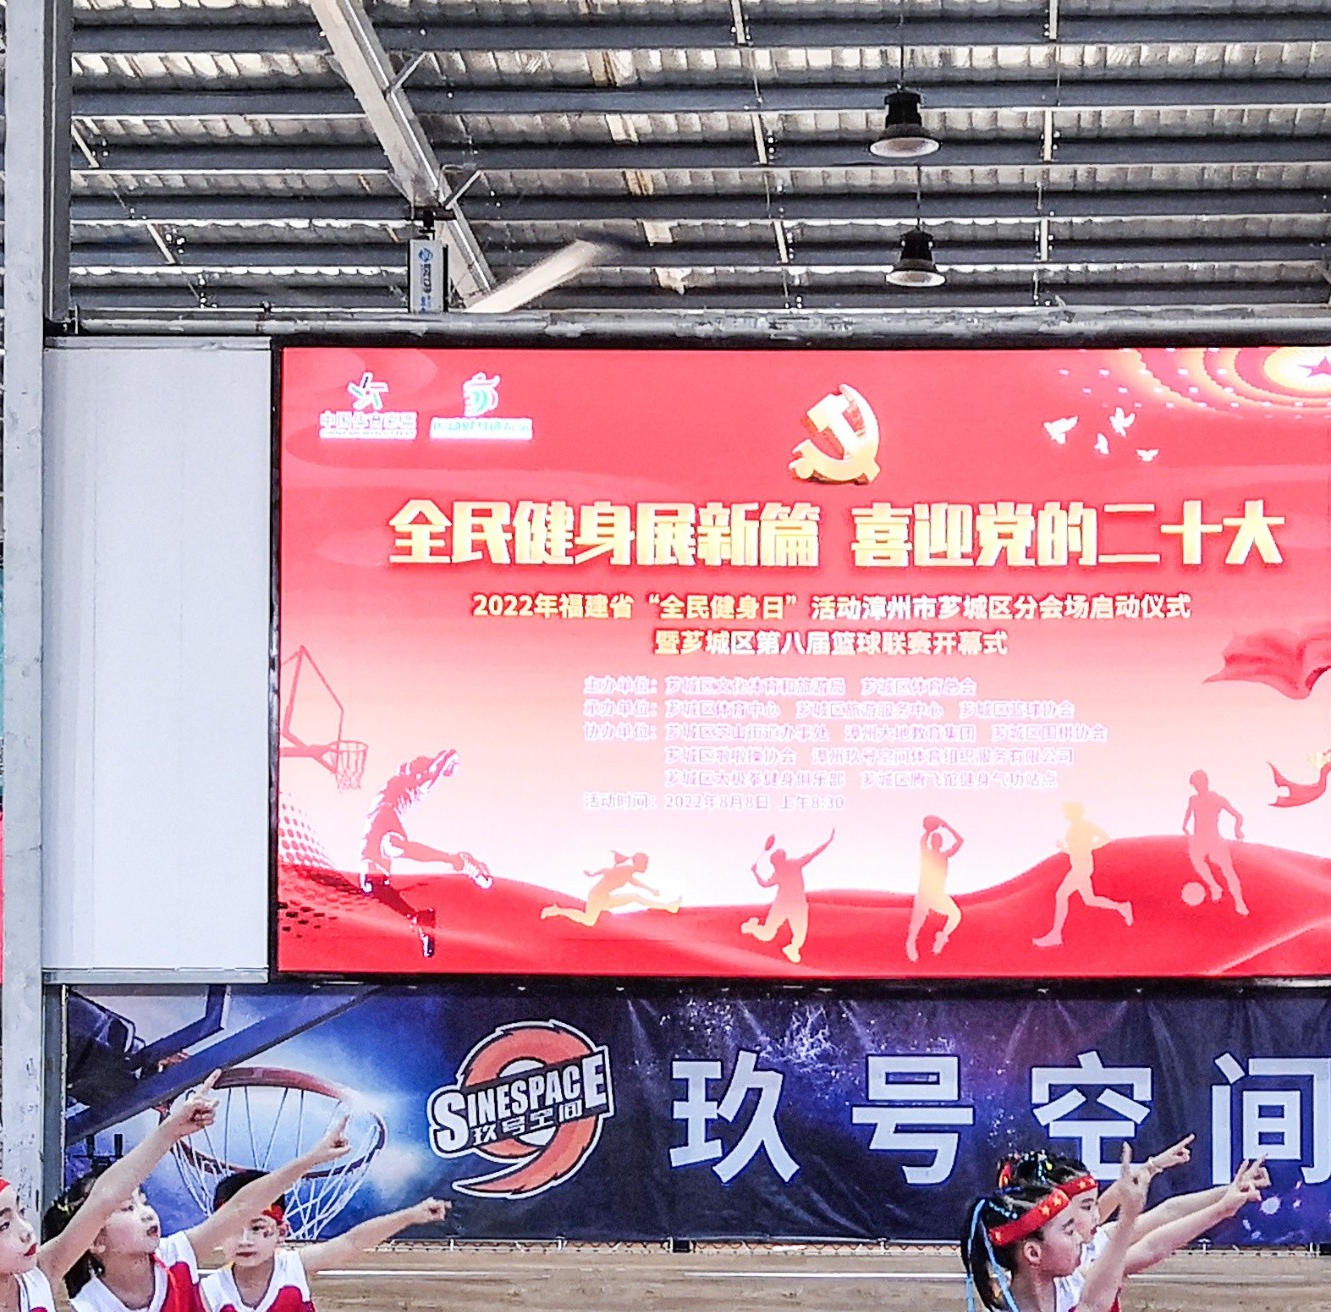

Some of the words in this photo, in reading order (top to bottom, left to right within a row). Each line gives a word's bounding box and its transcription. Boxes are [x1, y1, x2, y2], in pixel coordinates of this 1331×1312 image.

[388, 500, 822, 567] 全民健身展新篇
[850, 500, 1287, 567] 喜迎党的二十大
[653, 629, 1008, 657] 暨芗城区第八届篮球联赛开幕式
[433, 1052, 608, 1152] SINESPACE
[472, 1098, 583, 1147] 玖号空间
